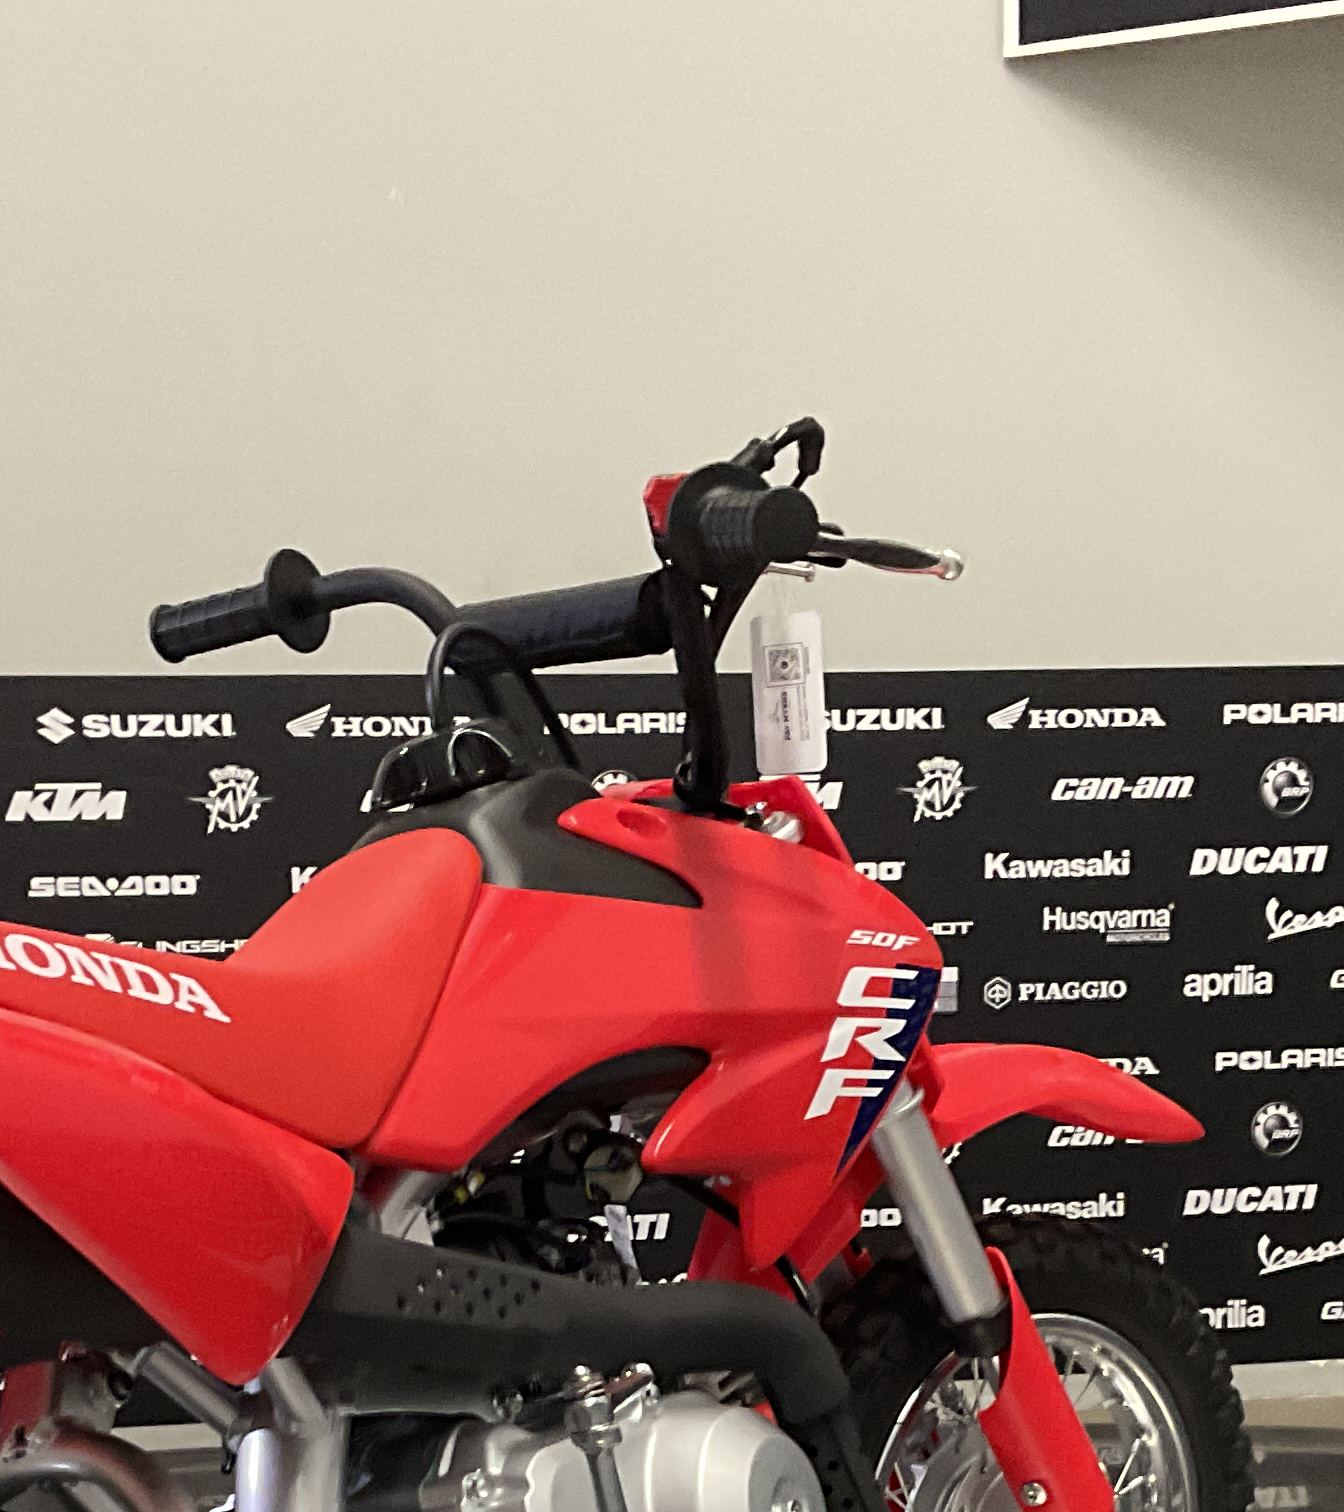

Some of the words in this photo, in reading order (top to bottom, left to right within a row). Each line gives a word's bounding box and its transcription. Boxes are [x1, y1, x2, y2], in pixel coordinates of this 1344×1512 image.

[81, 713, 237, 739] SUZUKI
[330, 713, 432, 740] HON
[1028, 707, 1167, 729] HONDA
[4, 782, 128, 822] KTM
[1050, 775, 1195, 801] can-am
[984, 849, 1131, 880] Kawasaki
[1189, 845, 1329, 876] DUCATI
[1042, 903, 1175, 933] Husqvarna
[846, 930, 920, 950] 50F
[1018, 979, 1128, 1002] PIAGGIO
[1182, 964, 1273, 1003] aprilia
[1182, 1183, 1318, 1216] DUCATI
[1199, 1300, 1266, 1330] rilia
